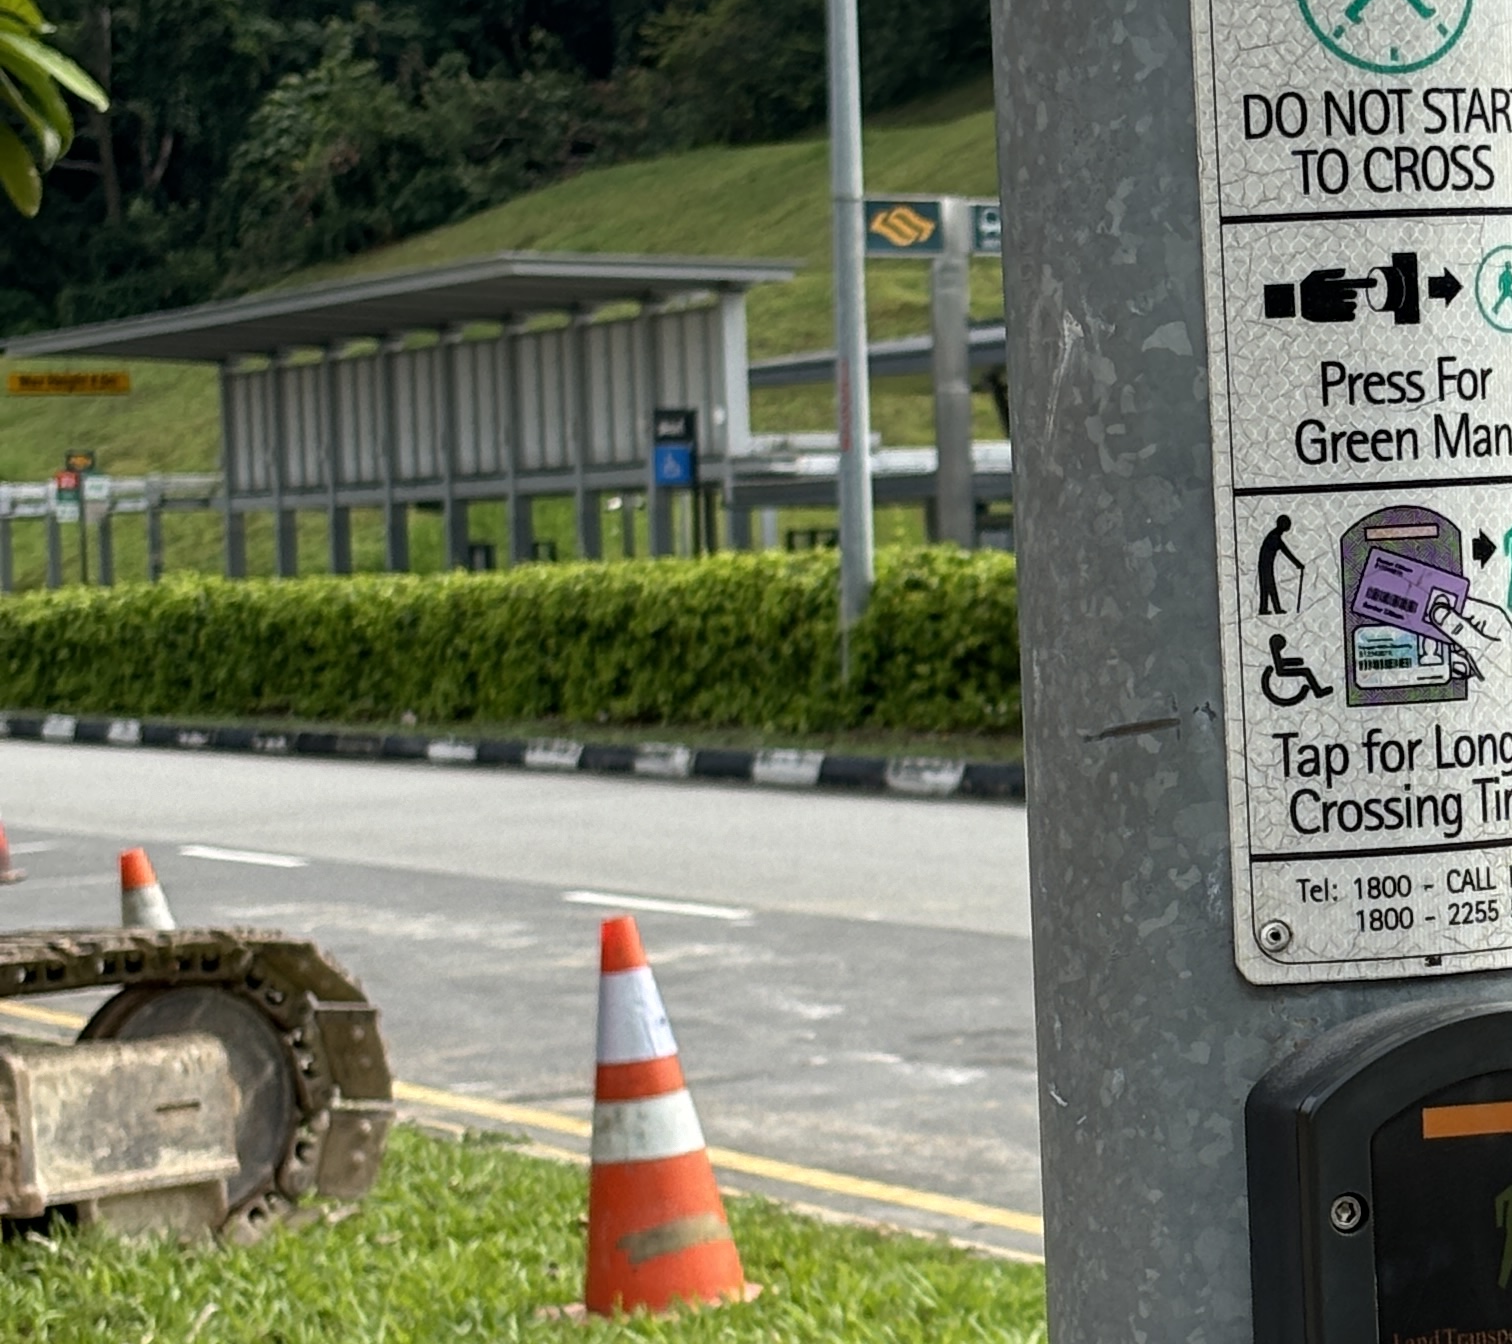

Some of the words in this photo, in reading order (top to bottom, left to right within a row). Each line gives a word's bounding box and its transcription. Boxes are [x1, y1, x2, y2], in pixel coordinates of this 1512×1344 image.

[1243, 92, 1308, 140] DO
[1325, 89, 1413, 137] NOT
[1292, 149, 1349, 195] TO
[1364, 145, 1495, 193] CROSS
[1320, 361, 1425, 406] Press
[1437, 356, 1493, 401] For
[1295, 419, 1418, 465] Green
[1434, 413, 1512, 458] Man
[1272, 733, 1349, 788] Tap
[1362, 728, 1422, 773] for
[1290, 784, 1462, 838] Crossing
[1296, 879, 1338, 903] Tel:
[1353, 875, 1412, 900] 1800
[1447, 867, 1496, 895] CALL
[1356, 907, 1414, 932] 1800
[1448, 900, 1500, 926] 2255
